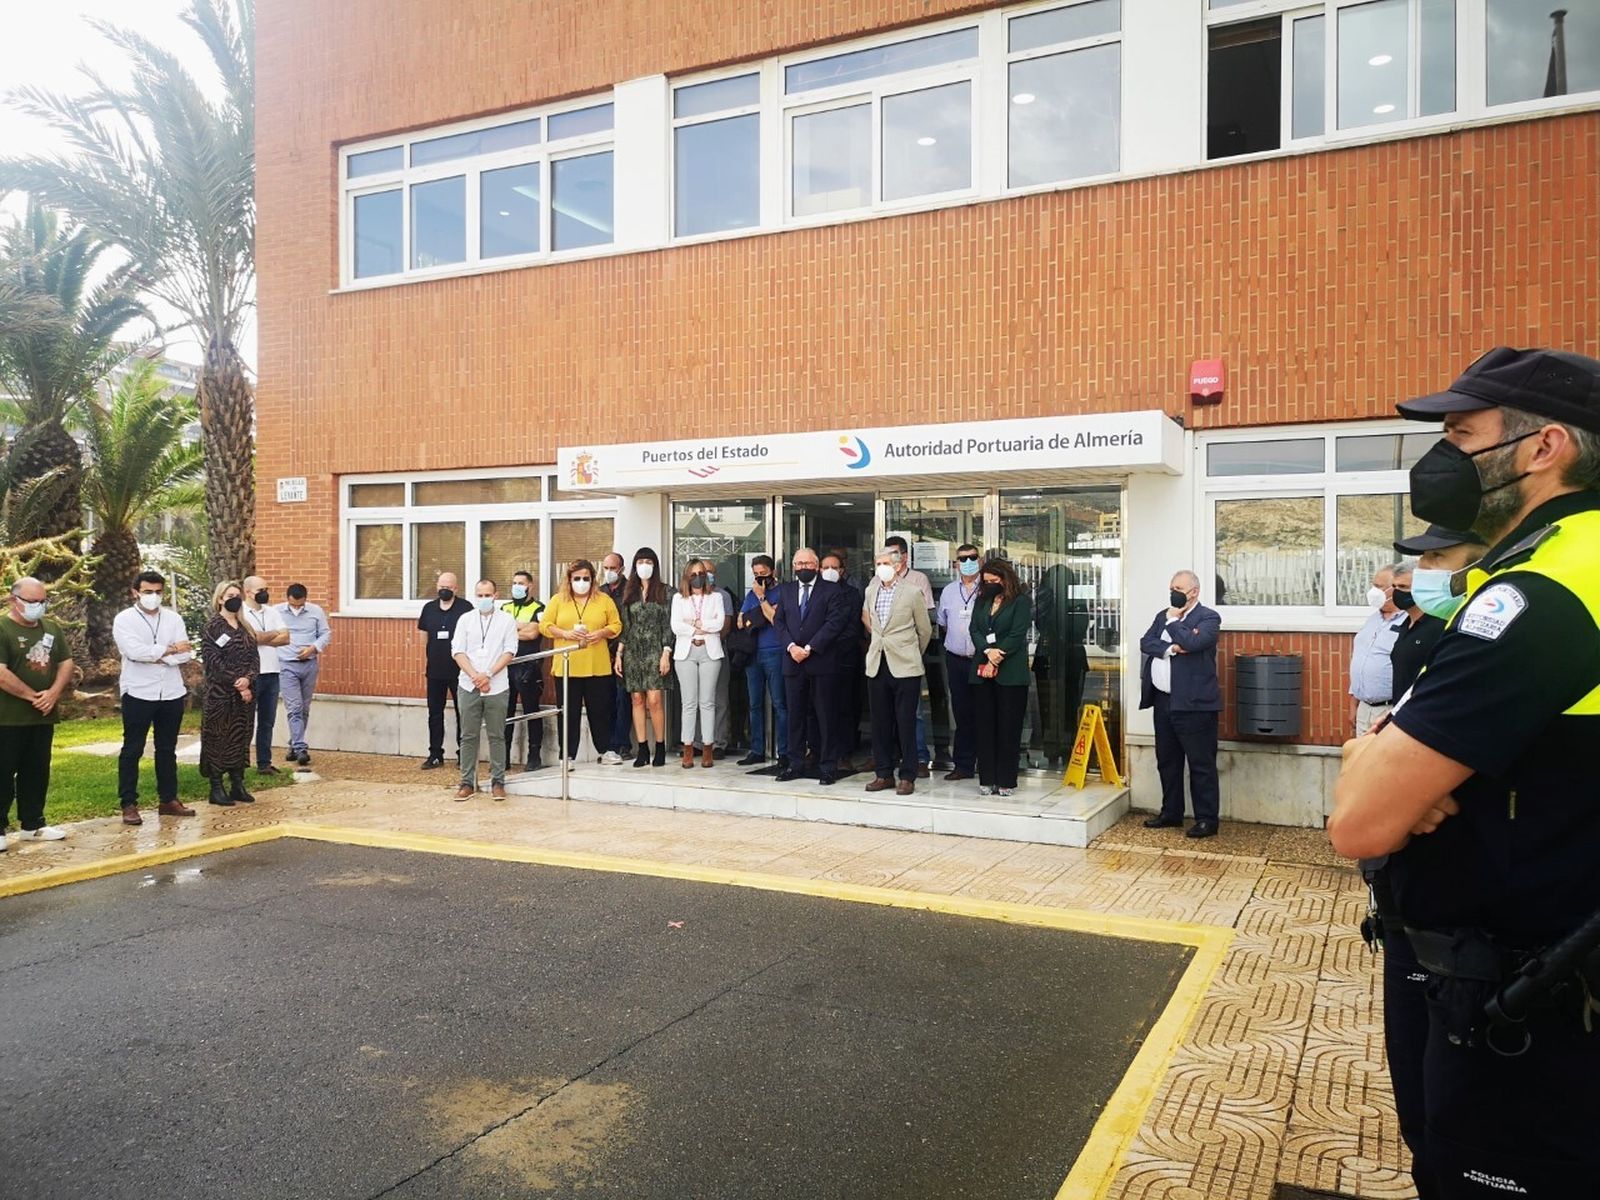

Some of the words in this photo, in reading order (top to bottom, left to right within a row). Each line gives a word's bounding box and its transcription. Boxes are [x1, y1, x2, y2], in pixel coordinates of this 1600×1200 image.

[1193, 376, 1219, 385] FUEGO
[642, 450, 693, 463] Puertos
[697, 446, 718, 460] del
[722, 443, 769, 459] Estado
[884, 439, 963, 458] Autoridad
[967, 435, 1044, 454] Portuaria
[1048, 433, 1070, 450] de
[1074, 429, 1143, 448] Almería
[1463, 1171, 1528, 1194] PORTUARIA
[1470, 1169, 1517, 1186] POLICIA
